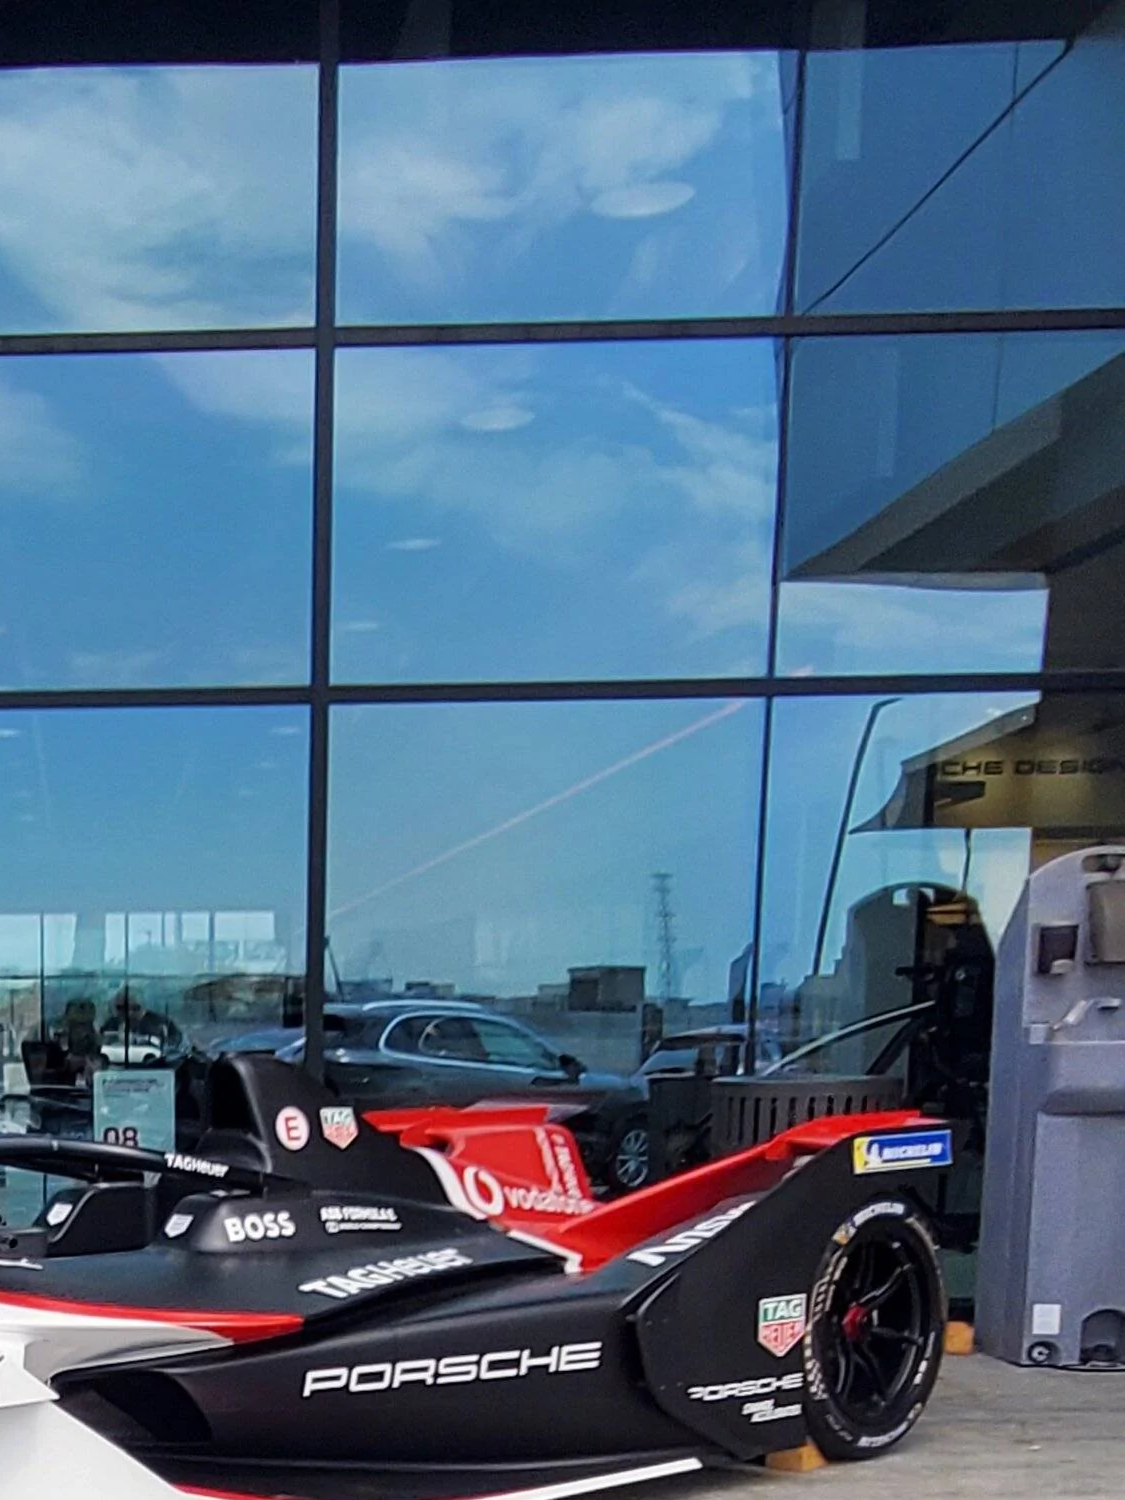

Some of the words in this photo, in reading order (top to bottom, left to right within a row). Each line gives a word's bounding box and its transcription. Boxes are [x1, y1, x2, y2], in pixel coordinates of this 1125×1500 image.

[103, 1126, 139, 1149] 08
[284, 1116, 302, 1142] E
[224, 1210, 296, 1243] BOSS
[763, 1301, 802, 1320] TAG
[302, 1341, 603, 1398] PORSCHE
